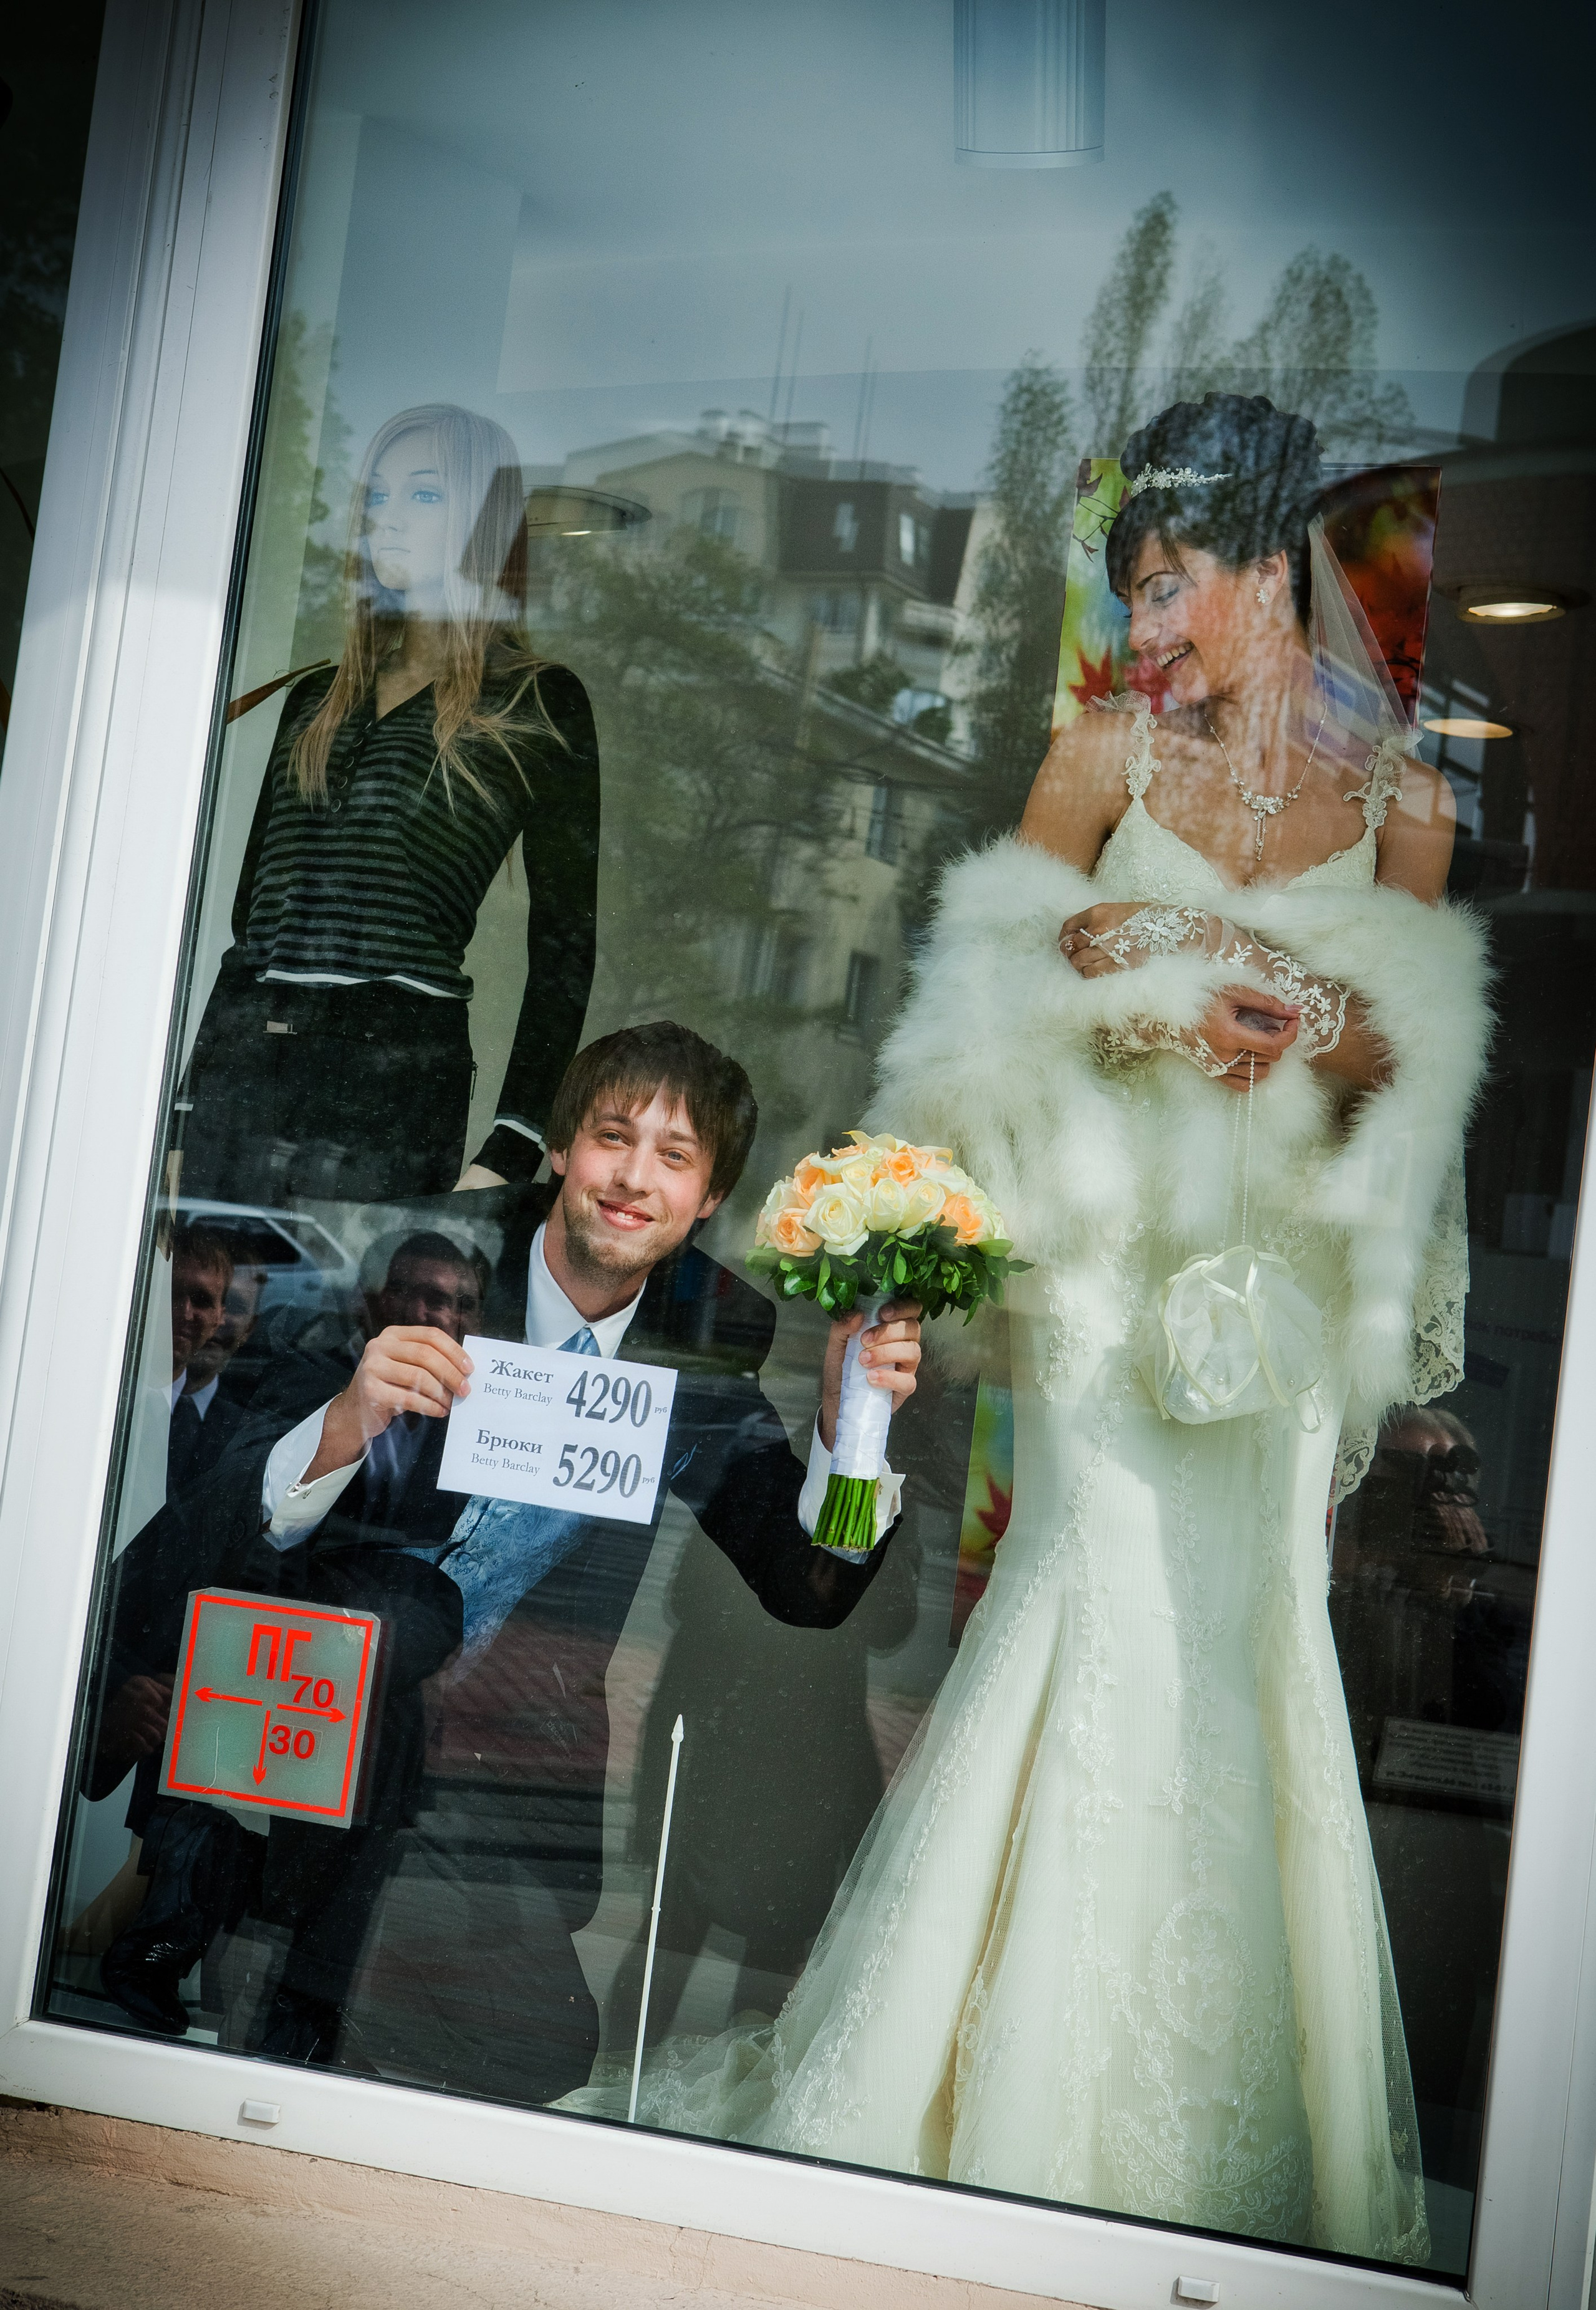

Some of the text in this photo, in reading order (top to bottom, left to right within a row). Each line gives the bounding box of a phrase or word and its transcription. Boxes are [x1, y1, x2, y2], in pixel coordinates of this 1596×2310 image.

[489, 1359, 554, 1384] Жакет
[484, 1383, 553, 1406] Betty Barclay
[566, 1370, 652, 1427] 4290
[476, 1429, 543, 1453] Брюки
[471, 1453, 541, 1476] Betty Barclay
[552, 1443, 642, 1498] 5290
[246, 1624, 312, 1682] ПГ
[291, 1675, 335, 1708] 70
[269, 1725, 315, 1759] 30
